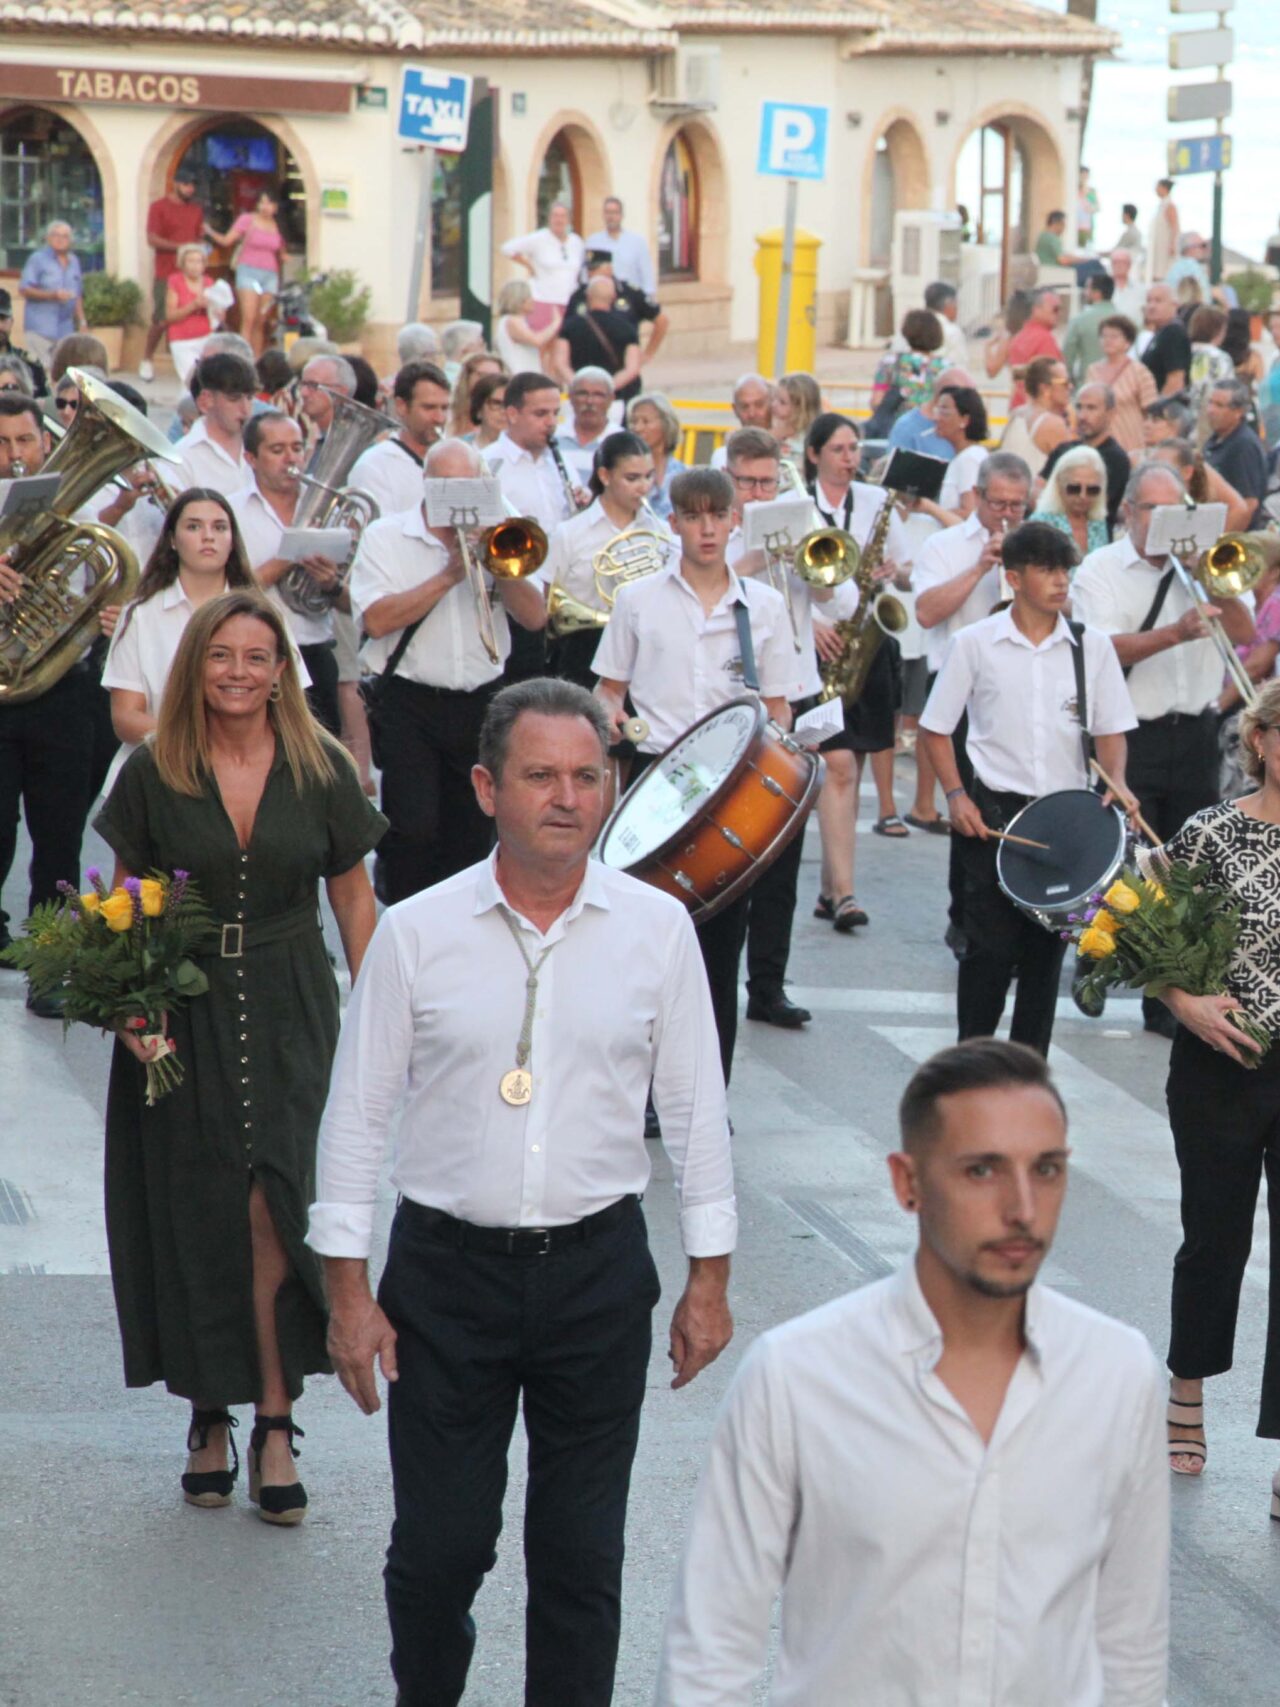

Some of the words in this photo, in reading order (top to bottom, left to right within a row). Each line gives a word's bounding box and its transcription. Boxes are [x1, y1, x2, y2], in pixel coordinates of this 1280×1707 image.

[57, 70, 200, 104] TABACOS
[404, 92, 462, 120] TAXI
[768, 109, 816, 170] P
